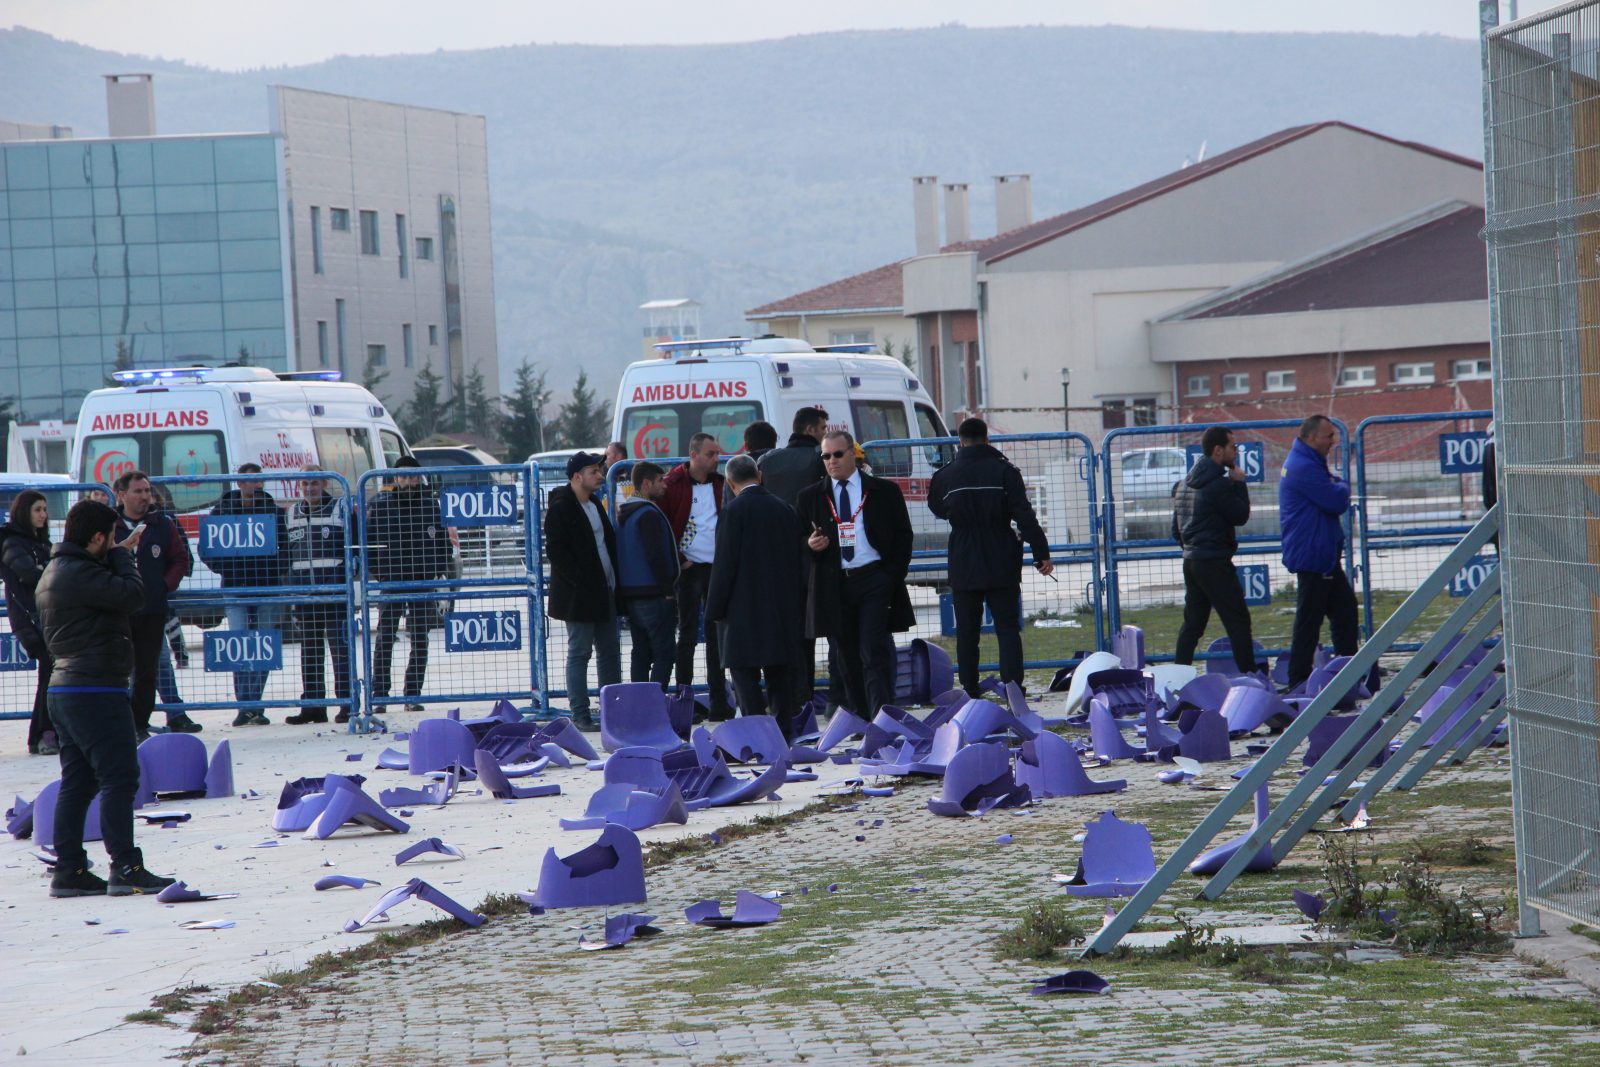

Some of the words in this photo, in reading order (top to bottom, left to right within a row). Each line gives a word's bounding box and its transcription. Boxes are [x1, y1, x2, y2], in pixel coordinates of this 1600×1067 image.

[631, 381, 748, 403] AMBULANS
[91, 410, 209, 431] AMBULANS
[642, 437, 671, 455] 112
[445, 485, 513, 518] POLİS
[207, 517, 266, 549] POLİS
[449, 611, 517, 645] POLİS
[213, 631, 274, 663] POLİS
